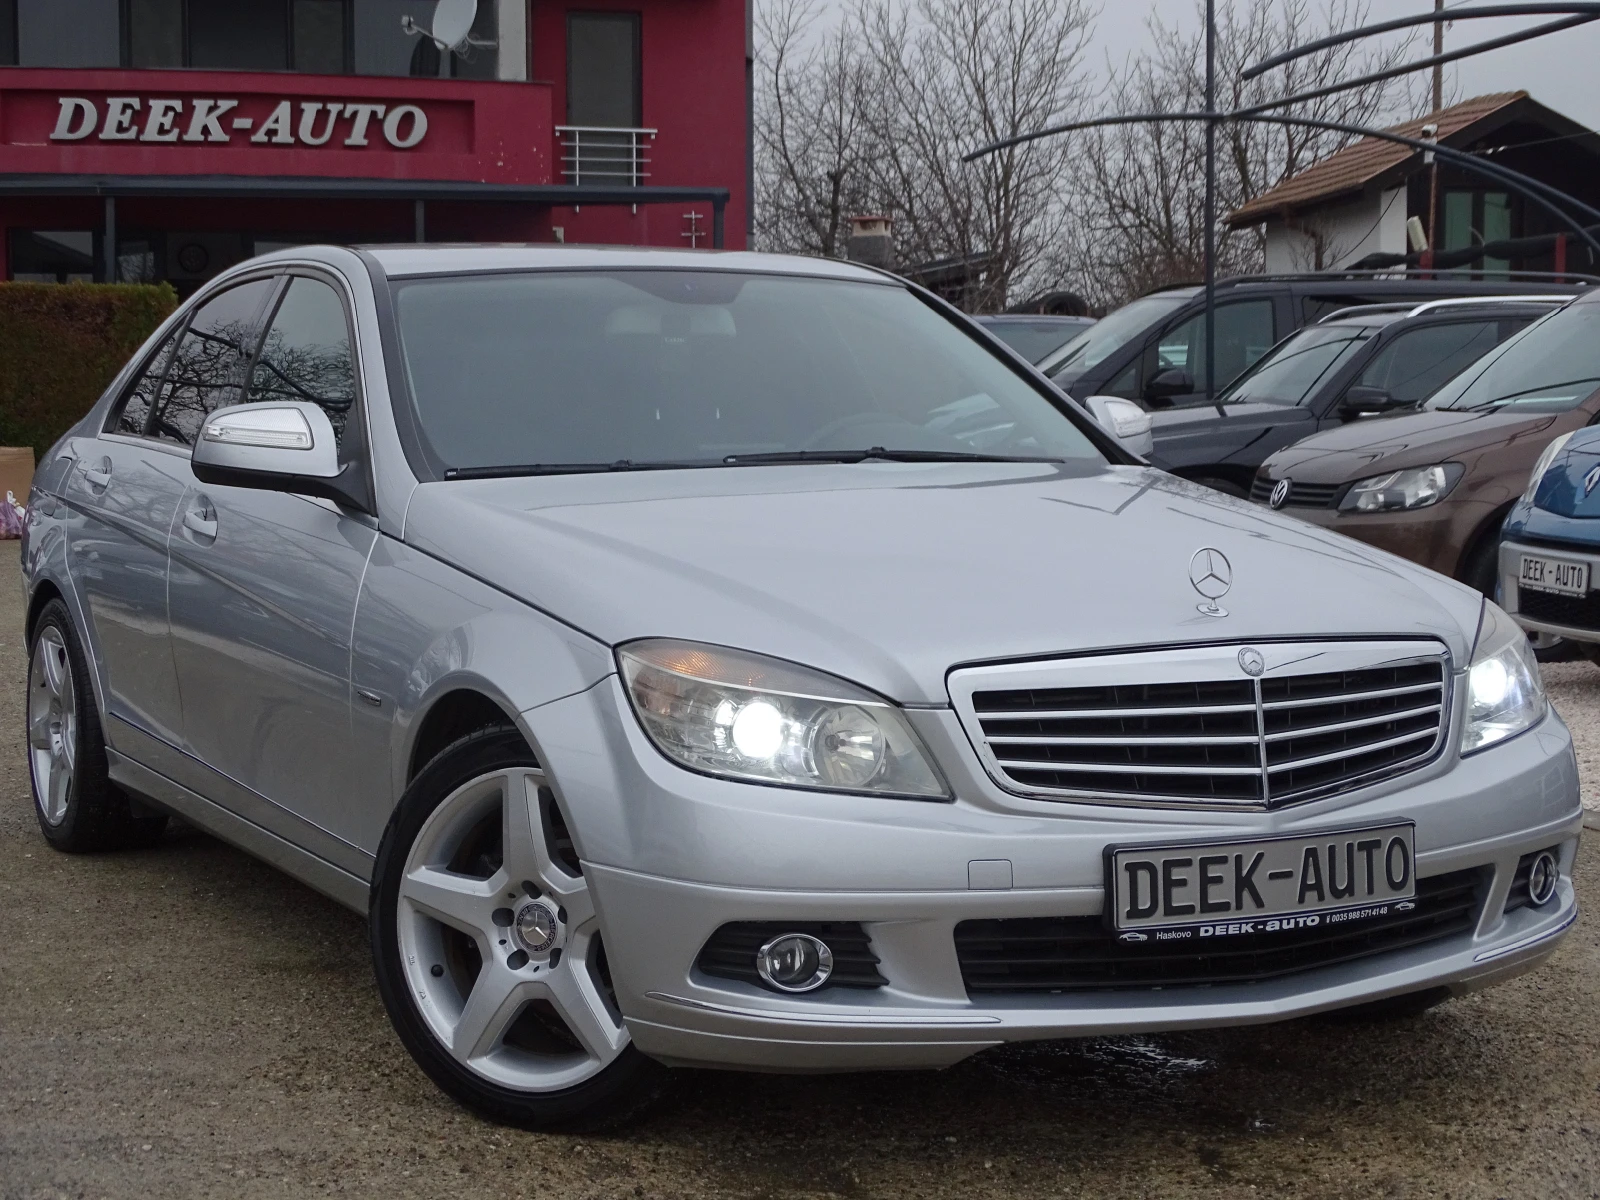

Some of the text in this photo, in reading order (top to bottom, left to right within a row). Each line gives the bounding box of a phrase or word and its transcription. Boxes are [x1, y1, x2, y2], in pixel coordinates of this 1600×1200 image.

[50, 97, 428, 148] DEEK-AUTO
[1125, 836, 1410, 920] DEEK-AUTO
[1156, 930, 1192, 940] Haskovo
